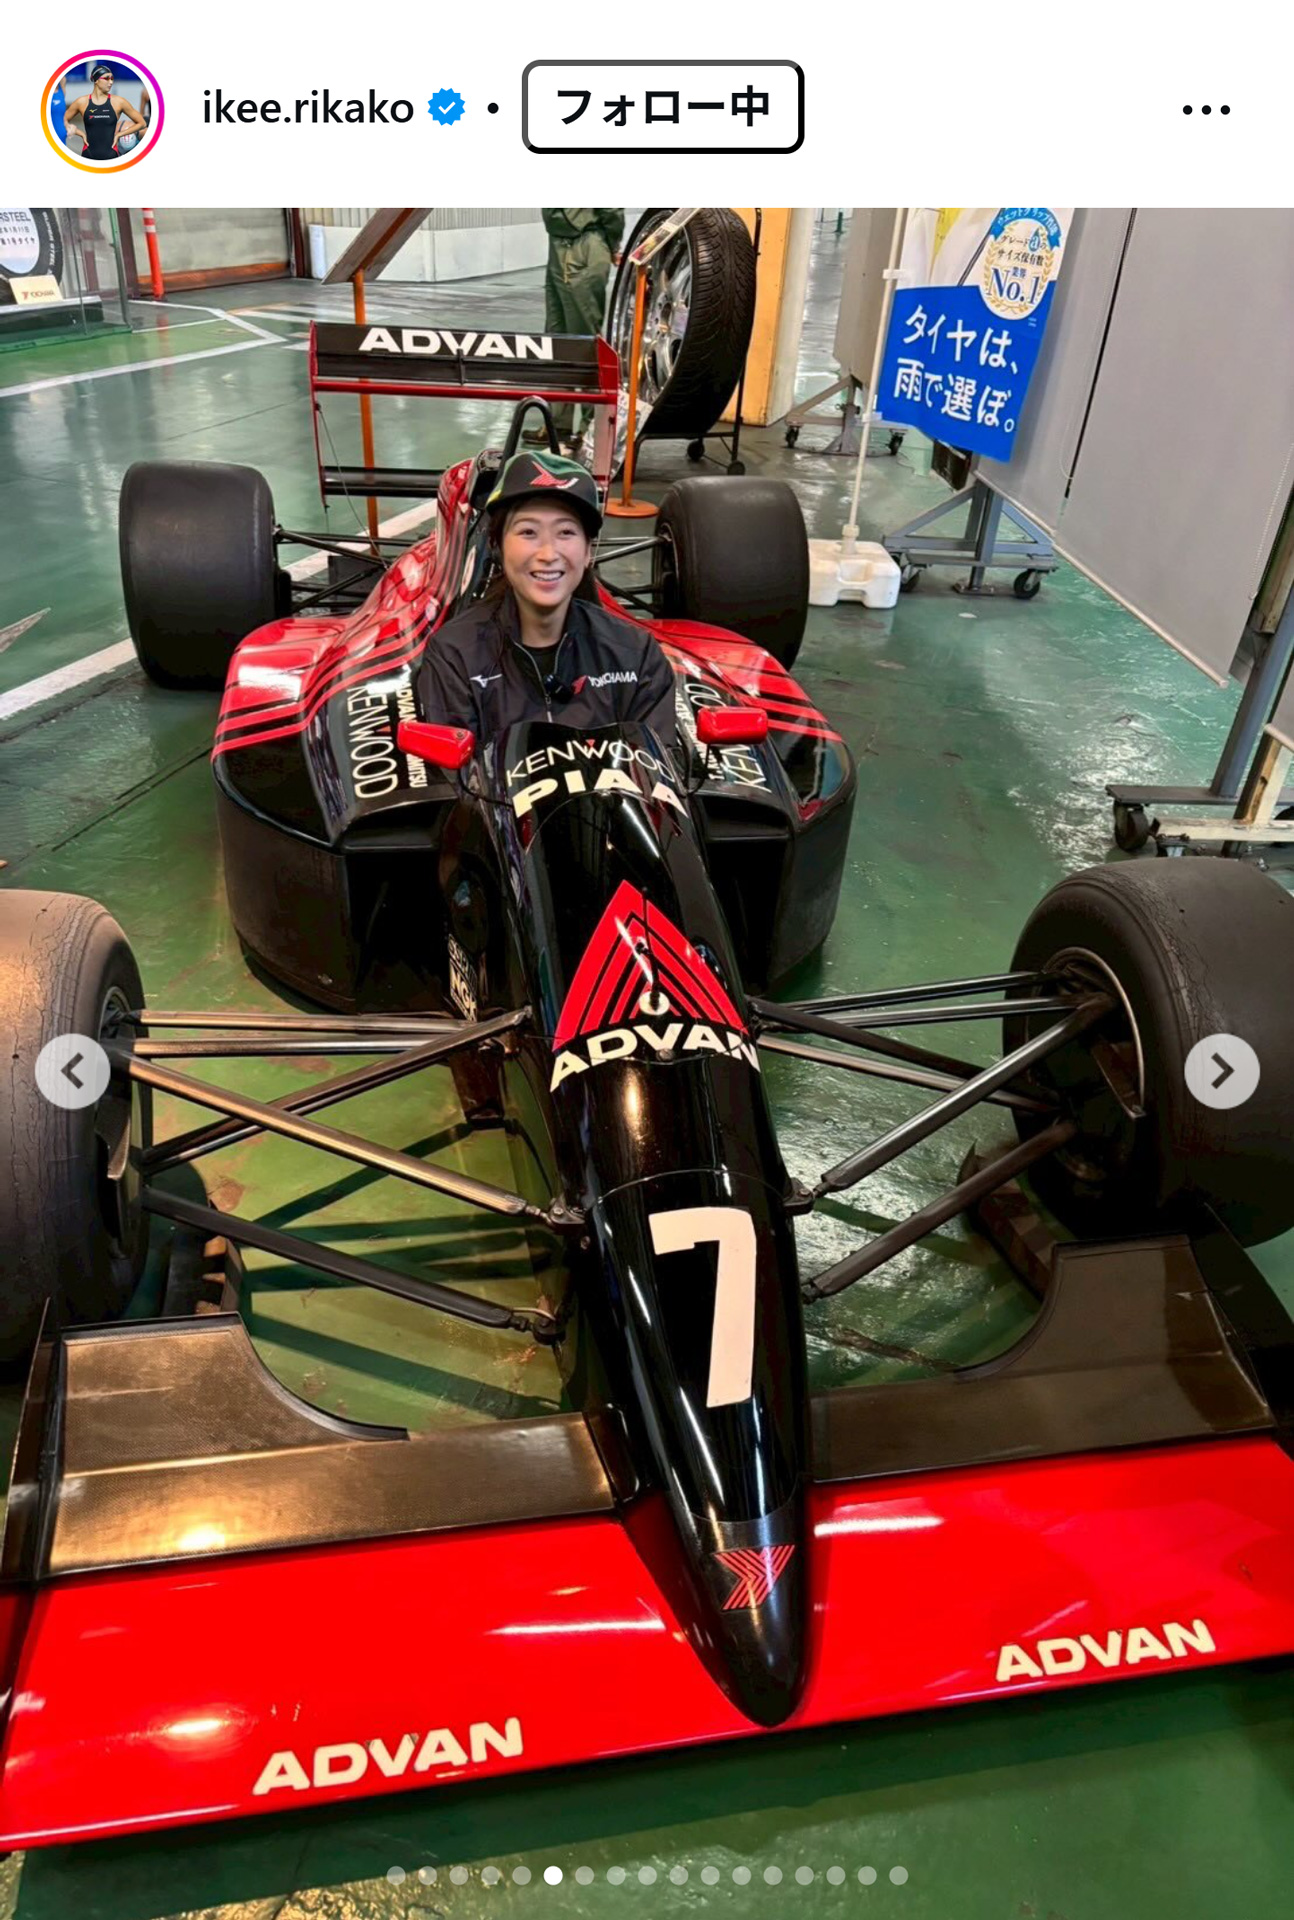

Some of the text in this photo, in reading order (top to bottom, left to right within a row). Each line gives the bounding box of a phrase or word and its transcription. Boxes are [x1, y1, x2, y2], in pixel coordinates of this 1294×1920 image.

[986, 267, 1040, 305] No.1
[358, 327, 554, 361] ADVAN
[903, 304, 1019, 375] タイヤは、
[893, 357, 1016, 433] 雨で選ぼ。
[346, 685, 398, 798] KENWOOD
[506, 739, 676, 788] KENWOOD
[512, 768, 689, 819] PIAA
[550, 1022, 761, 1093] ADVAN
[649, 1206, 757, 1408] 7
[995, 1618, 1216, 1683] ADVAN
[252, 1716, 524, 1796] ADVAN
